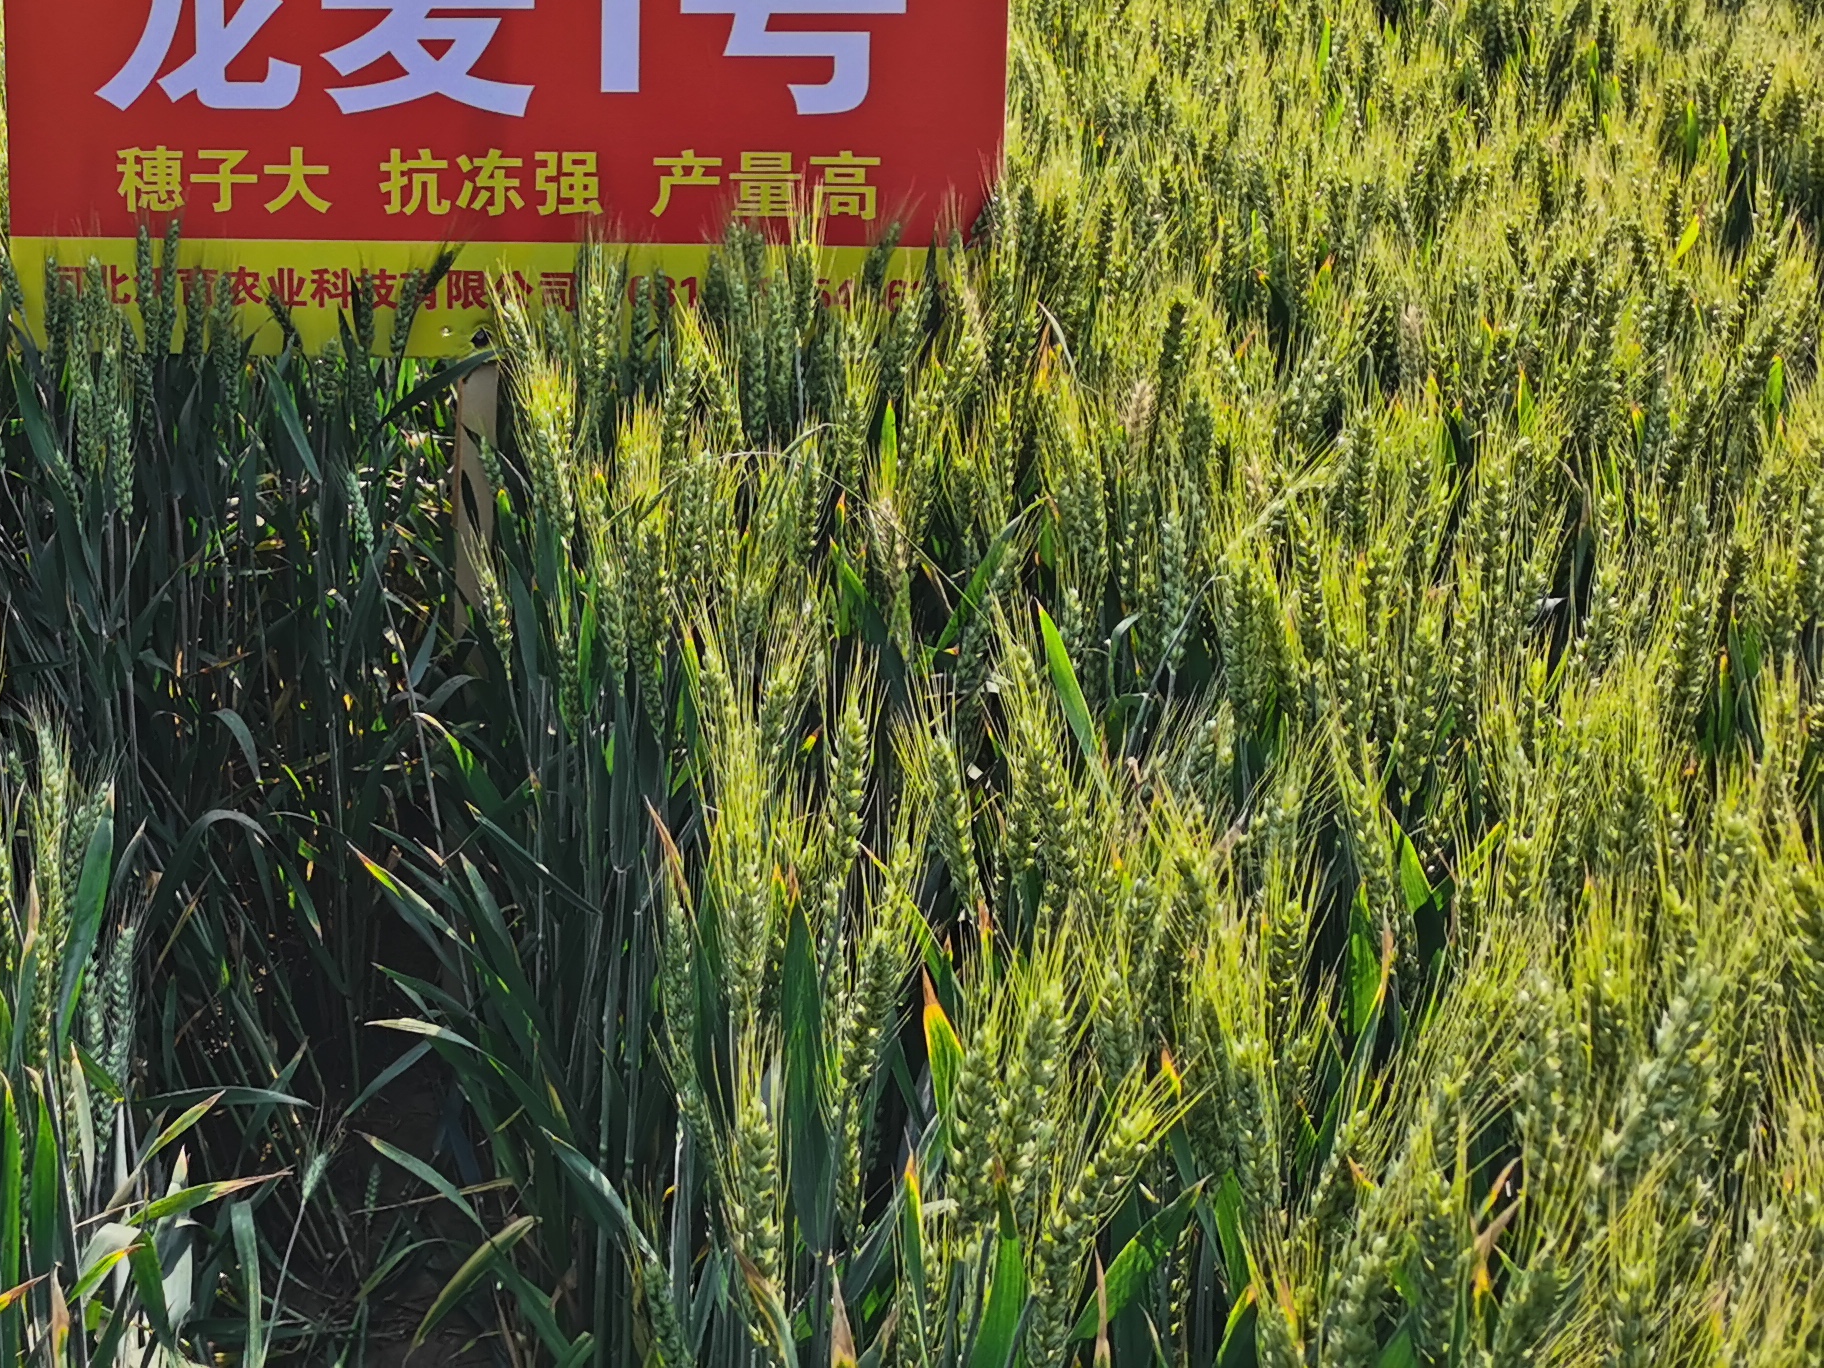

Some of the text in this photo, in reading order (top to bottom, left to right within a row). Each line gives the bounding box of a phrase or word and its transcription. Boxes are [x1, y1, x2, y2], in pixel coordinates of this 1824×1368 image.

[379, 148, 602, 216] 抗冻强
[650, 149, 881, 220] 产量高
[50, 264, 579, 312] 北育农业科技有限公司
